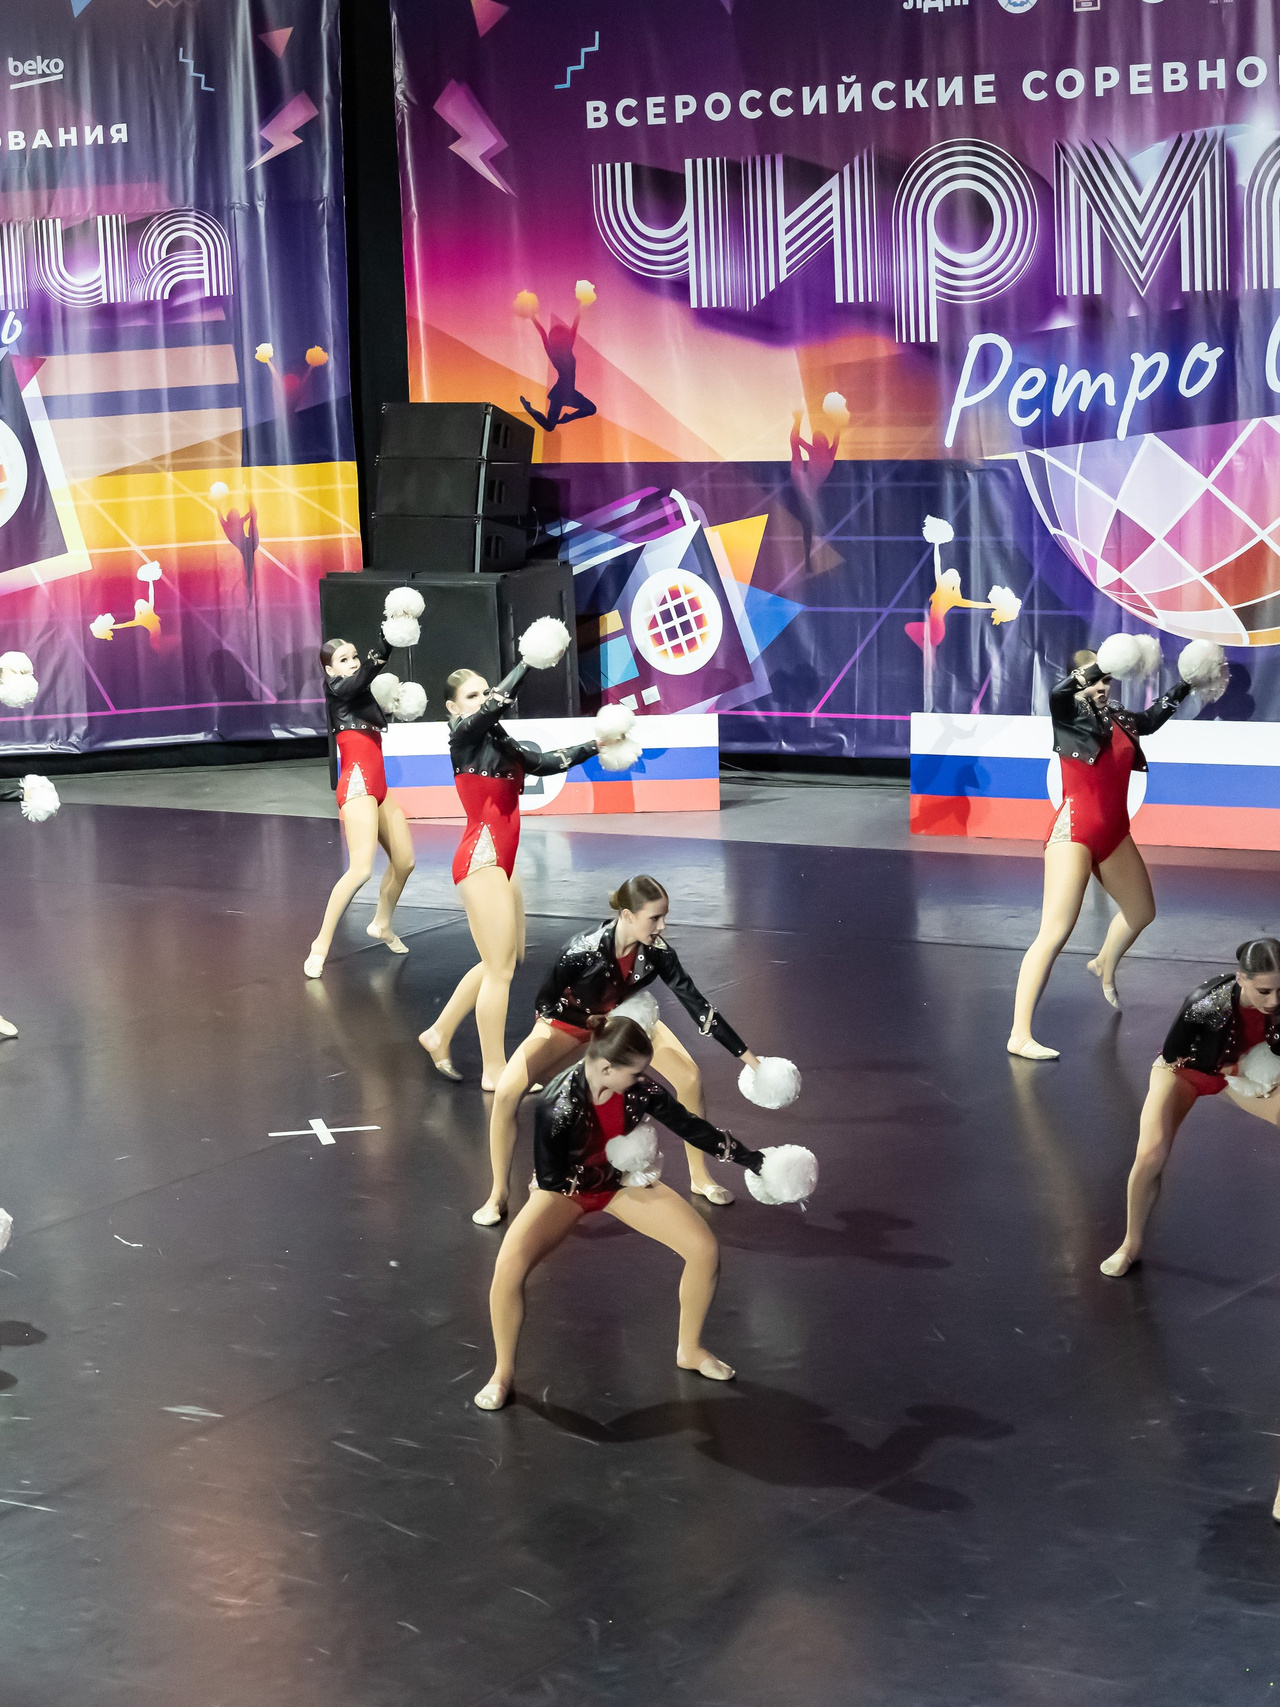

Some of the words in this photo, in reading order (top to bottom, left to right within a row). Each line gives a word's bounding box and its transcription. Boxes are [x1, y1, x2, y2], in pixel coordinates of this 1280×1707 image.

[8, 55, 64, 77] beko
[586, 73, 997, 129] ВСЕРОССИЙСКИЕ
[1022, 54, 1280, 101] СОРЕВНО
[592, 126, 1280, 343] ЧИРМ
[944, 332, 1225, 449] Ретро
